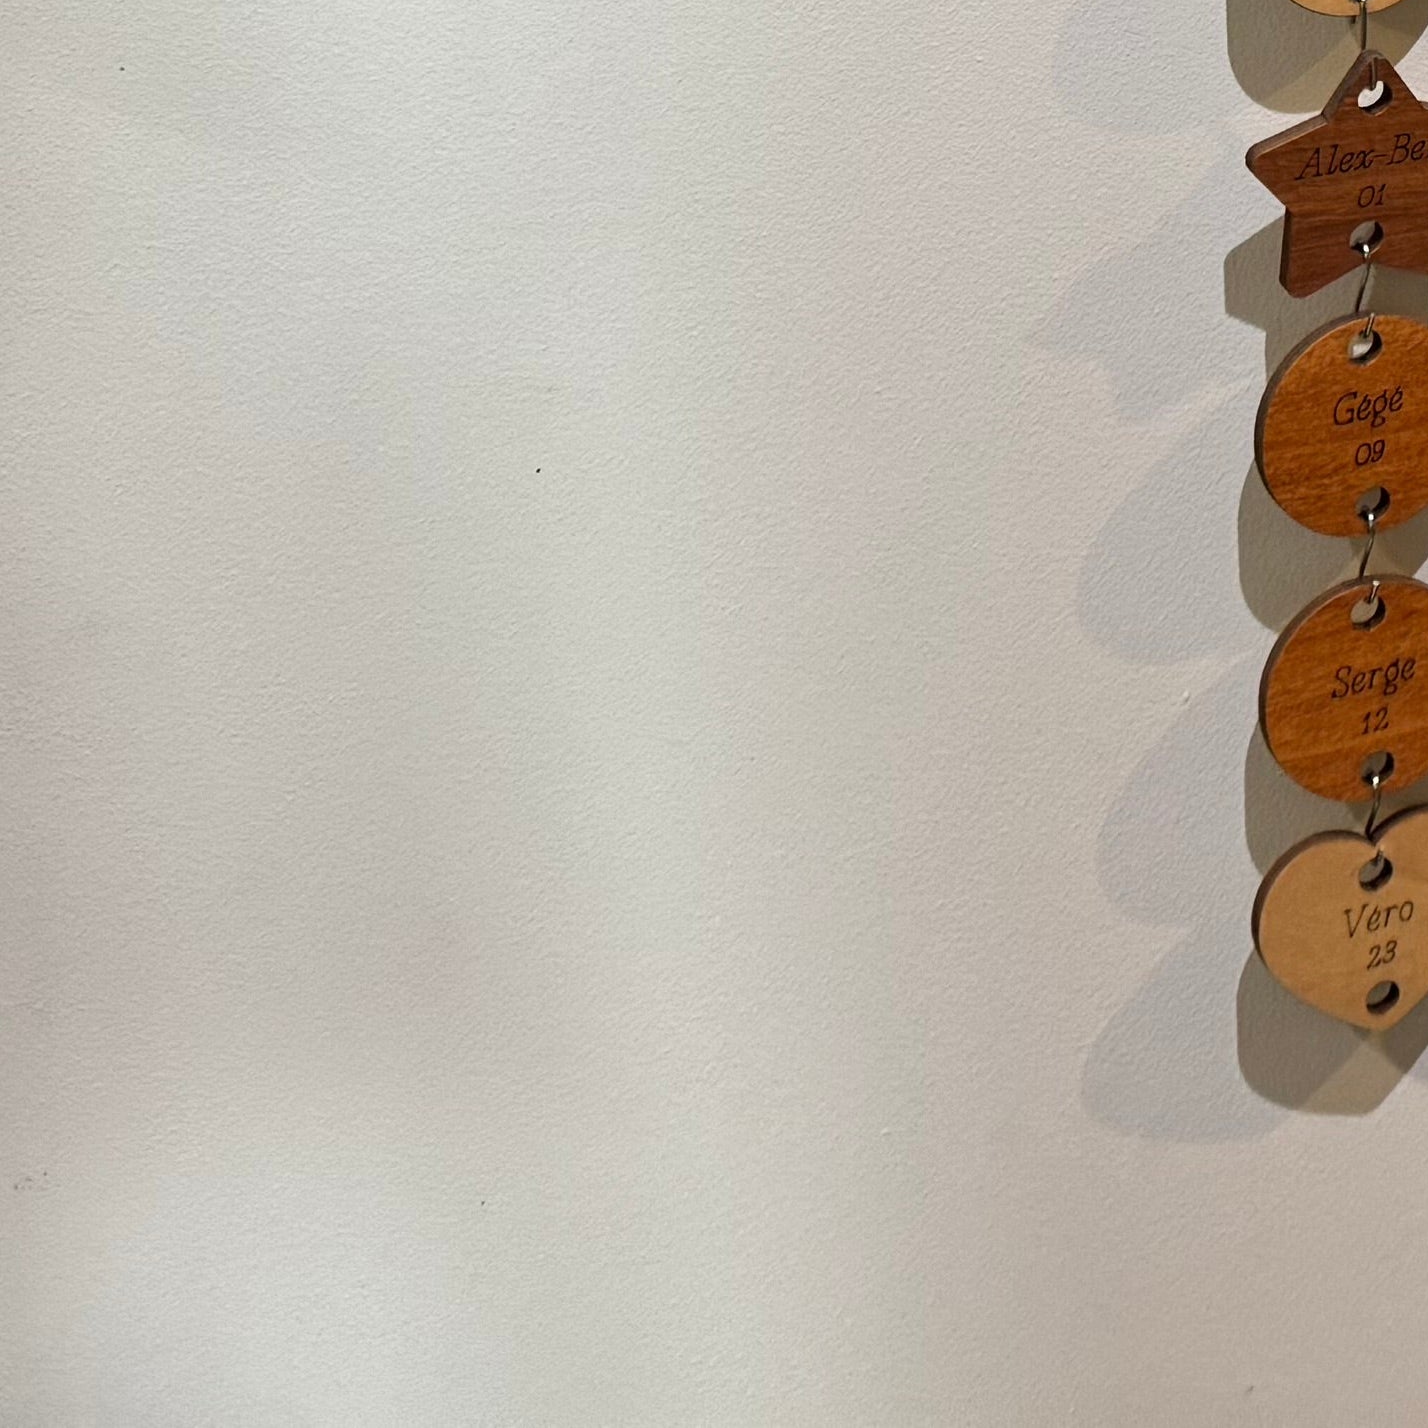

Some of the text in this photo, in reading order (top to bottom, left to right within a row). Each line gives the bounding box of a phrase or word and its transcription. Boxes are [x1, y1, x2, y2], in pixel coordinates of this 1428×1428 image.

[1356, 185, 1386, 209] 01
[1330, 386, 1404, 433] Gégé
[1354, 439, 1387, 467] 09
[1330, 652, 1416, 704] Serge
[1357, 707, 1390, 735] 12
[1344, 897, 1415, 941] Véro
[1366, 942, 1398, 969] 23
